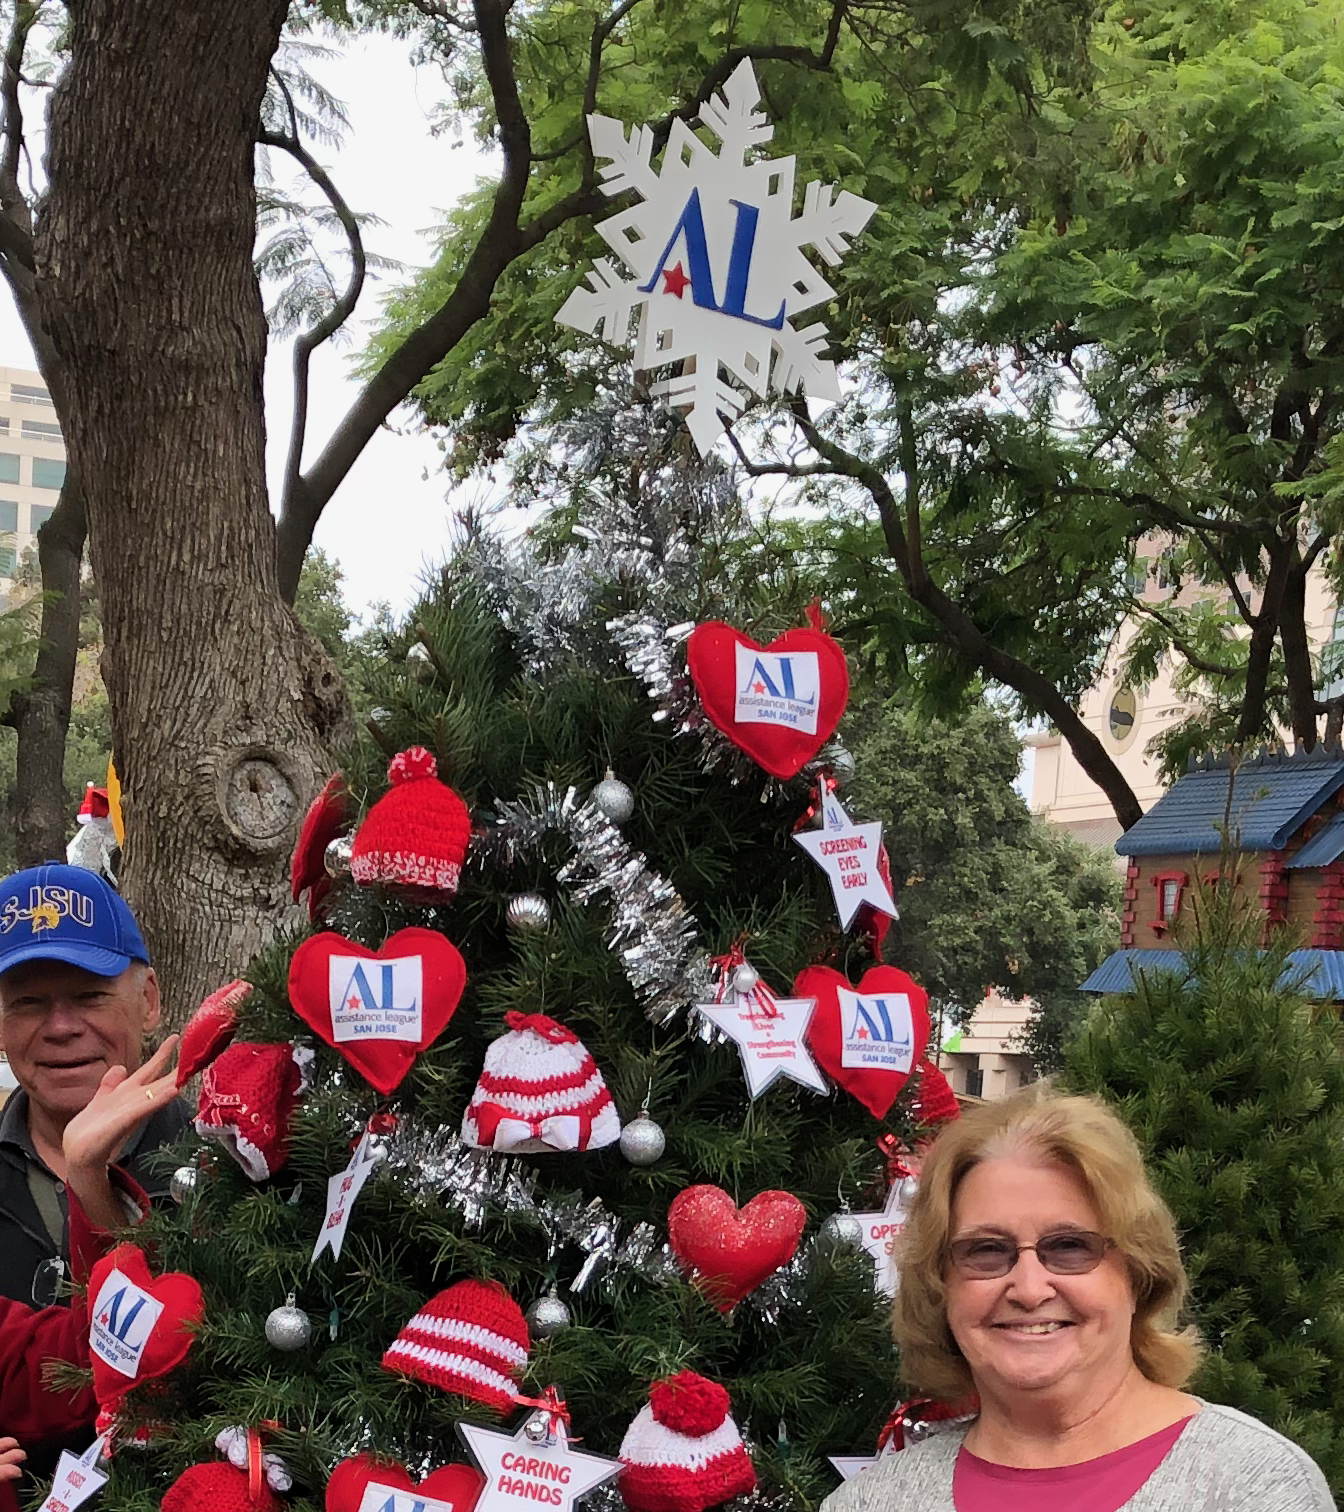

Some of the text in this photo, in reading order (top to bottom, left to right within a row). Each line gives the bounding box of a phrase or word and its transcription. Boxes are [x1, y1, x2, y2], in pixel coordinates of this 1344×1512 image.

[637, 186, 785, 330] AL
[740, 657, 814, 705] AL
[757, 709, 776, 718] SAN
[837, 856, 860, 871] EYES
[841, 872, 868, 889] EARLY
[0, 886, 94, 934] SJSU
[336, 961, 416, 1012] AL
[335, 1012, 382, 1023] assistance
[354, 1024, 397, 1034] SAN JOSE
[846, 998, 910, 1046] AL
[95, 1286, 149, 1353] AL
[501, 1452, 572, 1484] CARING
[497, 1475, 563, 1506] HANDS
